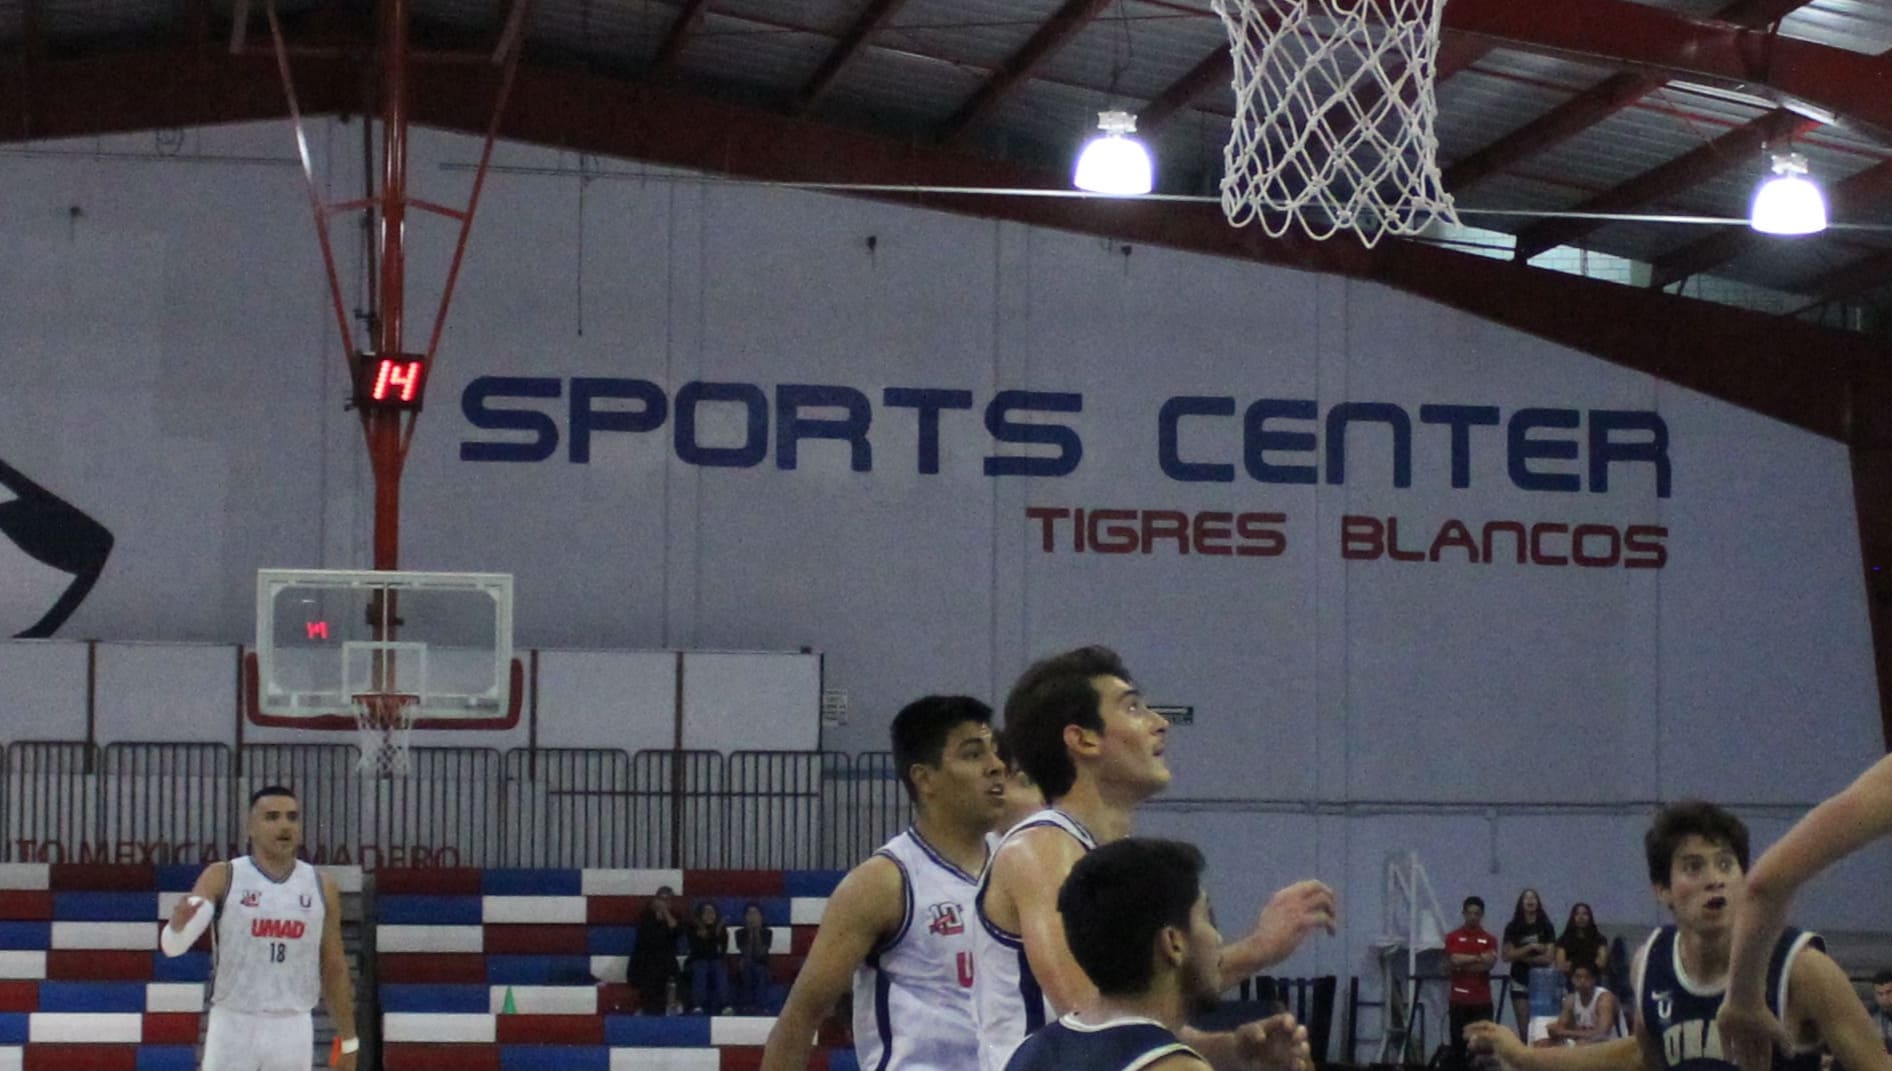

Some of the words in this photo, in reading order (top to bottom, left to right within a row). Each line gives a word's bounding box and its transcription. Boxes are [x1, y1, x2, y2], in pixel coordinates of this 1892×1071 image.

[372, 359, 423, 402] 14
[460, 375, 1083, 477] SPORTS
[1158, 395, 1672, 498] CENTER
[1026, 506, 1287, 557] TIGRES
[1341, 514, 1669, 569] BLANCOS
[251, 918, 305, 938] UMAD
[270, 942, 286, 963] 18
